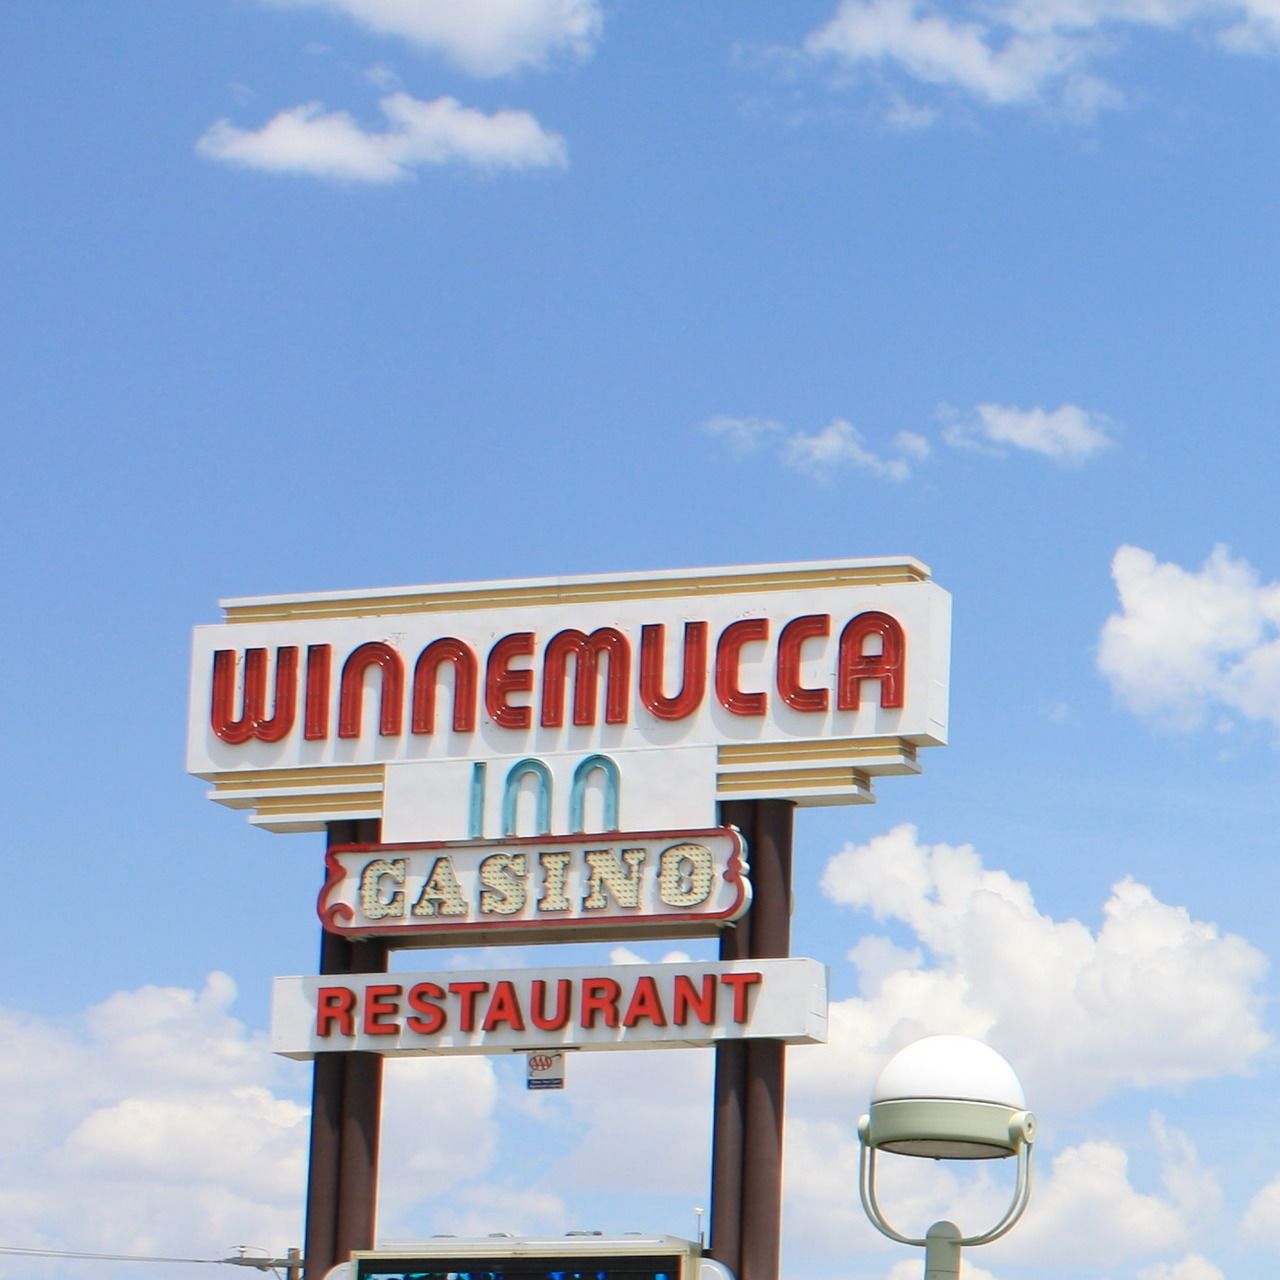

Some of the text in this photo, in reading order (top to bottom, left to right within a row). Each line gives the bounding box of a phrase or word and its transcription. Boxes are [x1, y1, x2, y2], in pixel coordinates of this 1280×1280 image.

[210, 610, 906, 745] WINNEMUCCA
[358, 842, 716, 920] CASINO
[315, 971, 763, 1038] RESTAURANT
